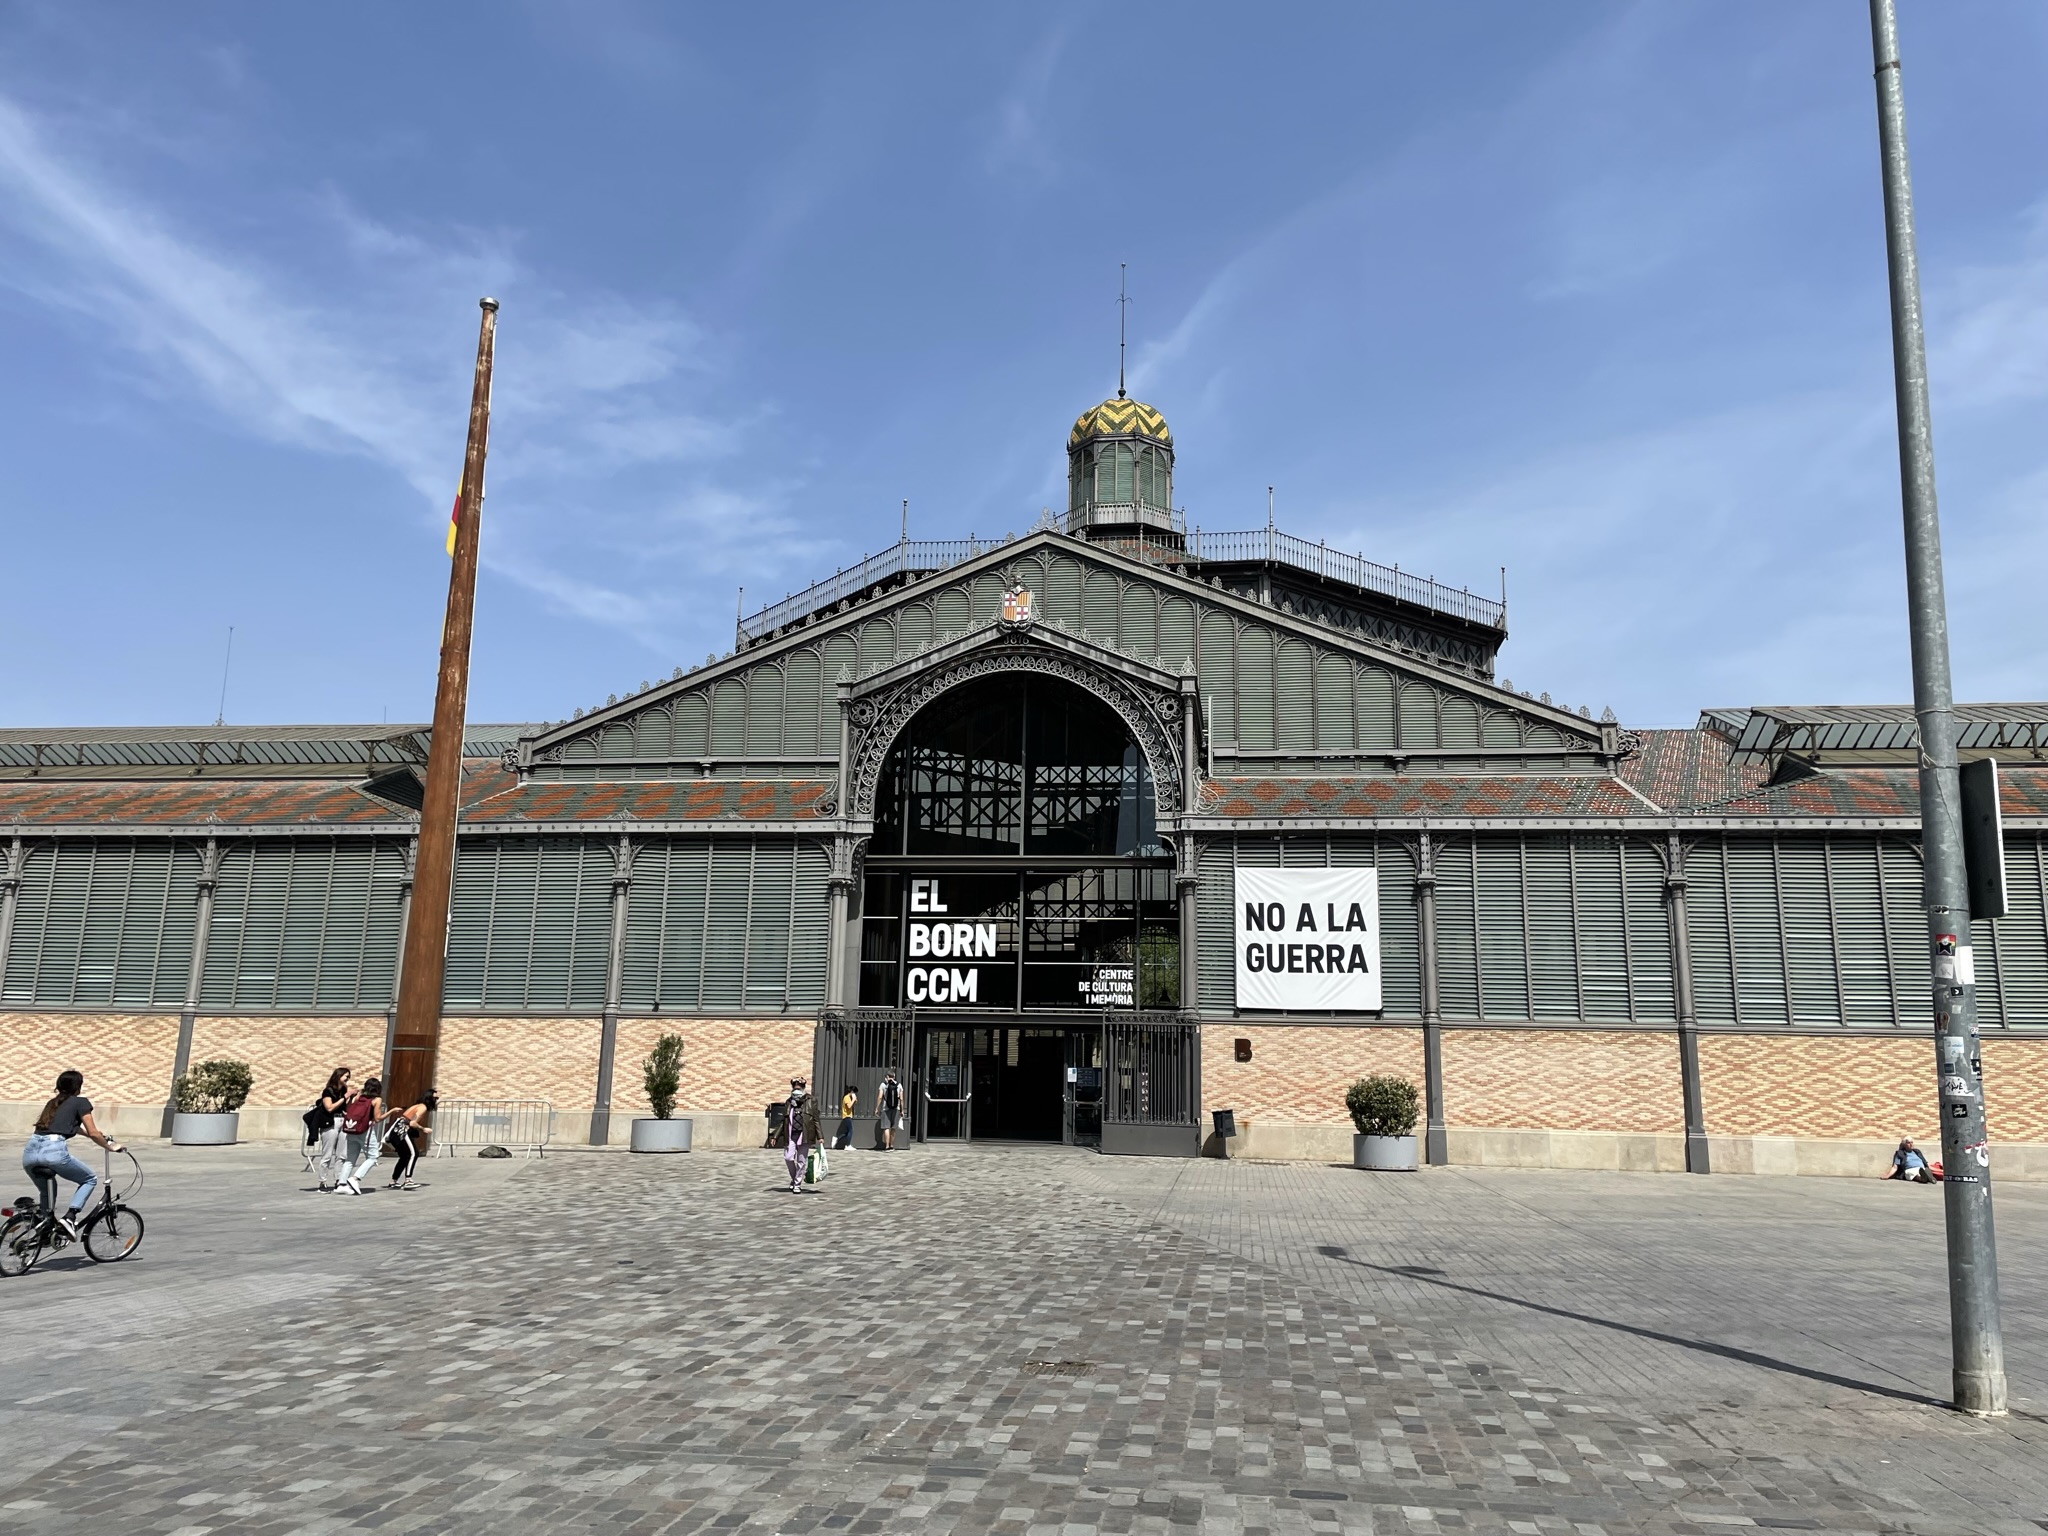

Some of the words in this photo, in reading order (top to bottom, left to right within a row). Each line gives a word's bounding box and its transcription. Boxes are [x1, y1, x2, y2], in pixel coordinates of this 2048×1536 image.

[1004, 635, 1030, 645] 1876
[910, 880, 948, 912] EL
[1245, 903, 1286, 932] NO
[1296, 903, 1317, 932] A
[1327, 903, 1367, 932] LA
[908, 924, 996, 958] BORN
[1246, 943, 1369, 973] GUERRA
[907, 968, 978, 1003] CCM
[1078, 981, 1091, 992] DE
[1092, 981, 1134, 992] CULTURA
[1099, 969, 1134, 980] CENTRE
[1085, 994, 1089, 1004] I
